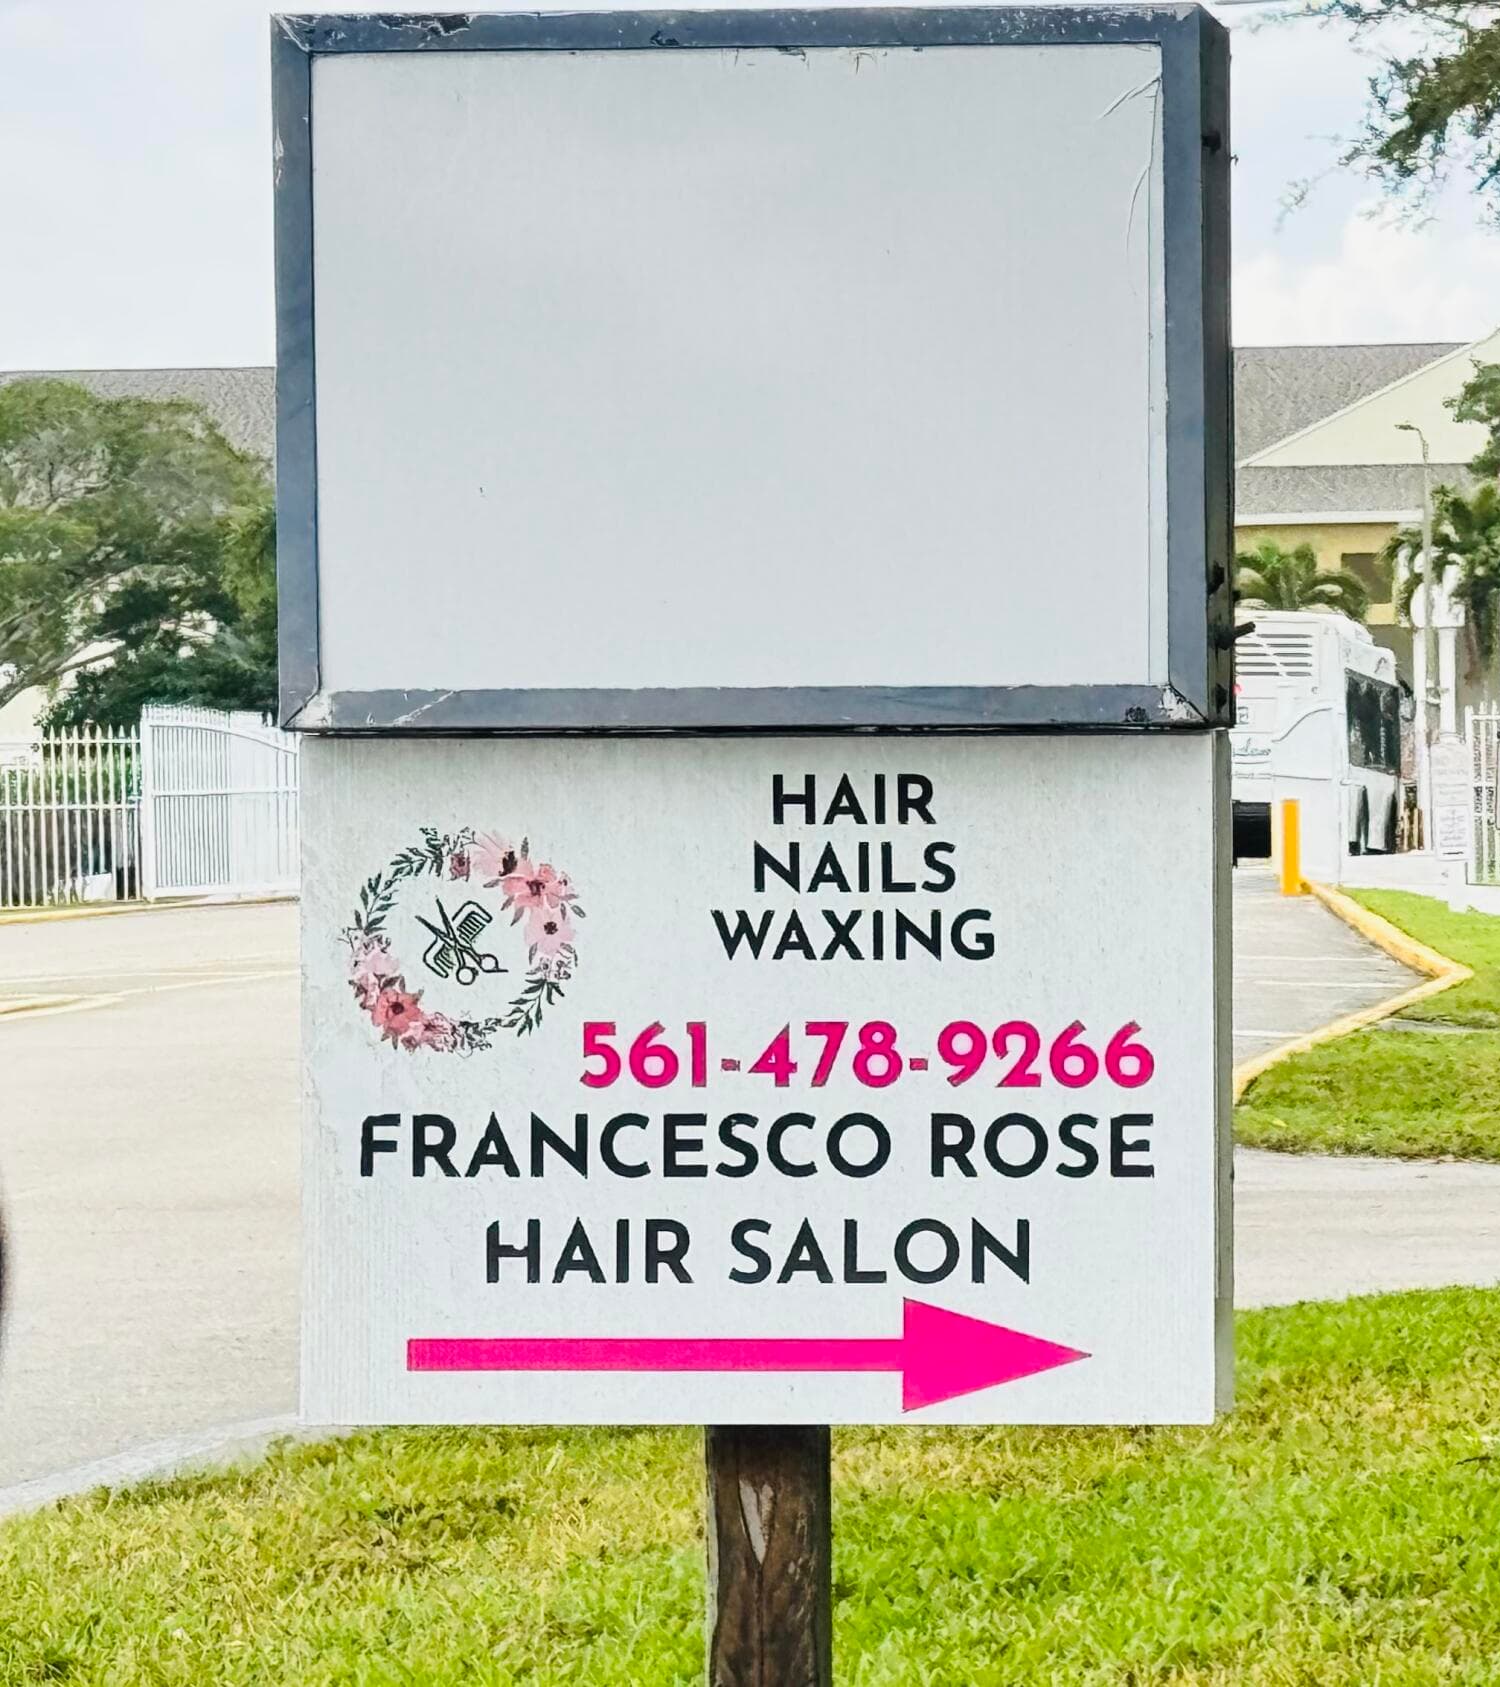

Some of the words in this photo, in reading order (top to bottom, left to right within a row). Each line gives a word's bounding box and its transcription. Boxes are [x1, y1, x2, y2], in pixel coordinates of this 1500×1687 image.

[772, 773, 936, 825] HAIR
[753, 841, 956, 893] NAILS
[710, 908, 995, 961] WAXING
[580, 1020, 1154, 1088] 561-478-9266
[360, 1111, 891, 1179] FRANCESCO
[931, 1112, 1155, 1179] ROSE
[486, 1217, 693, 1284] HAIR
[728, 1217, 1030, 1285] SALON
